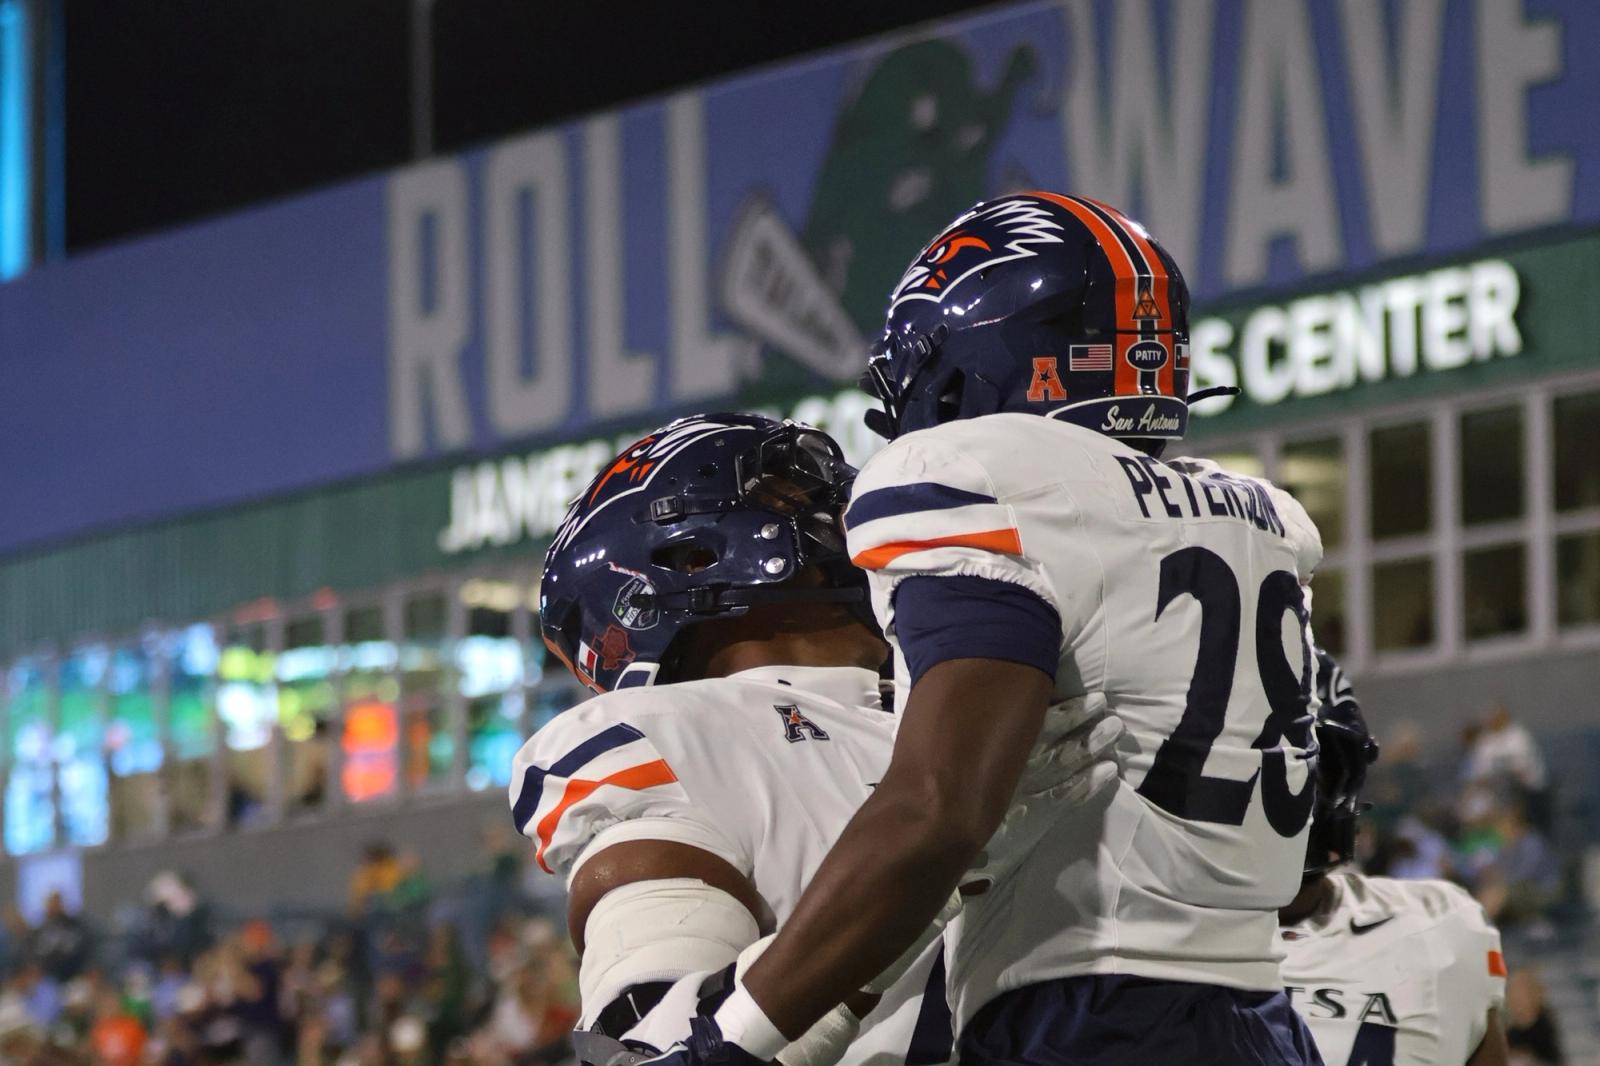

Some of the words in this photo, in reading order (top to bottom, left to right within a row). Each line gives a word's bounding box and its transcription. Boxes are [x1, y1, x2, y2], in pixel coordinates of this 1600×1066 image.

[387, 92, 744, 460] ROLL
[1063, 0, 1575, 290] WAVE
[1135, 350, 1162, 361] PATTY
[1240, 260, 1522, 404] CENTER
[1101, 405, 1134, 431] San
[1137, 403, 1180, 432] Antonio
[1134, 546, 1320, 838] 28
